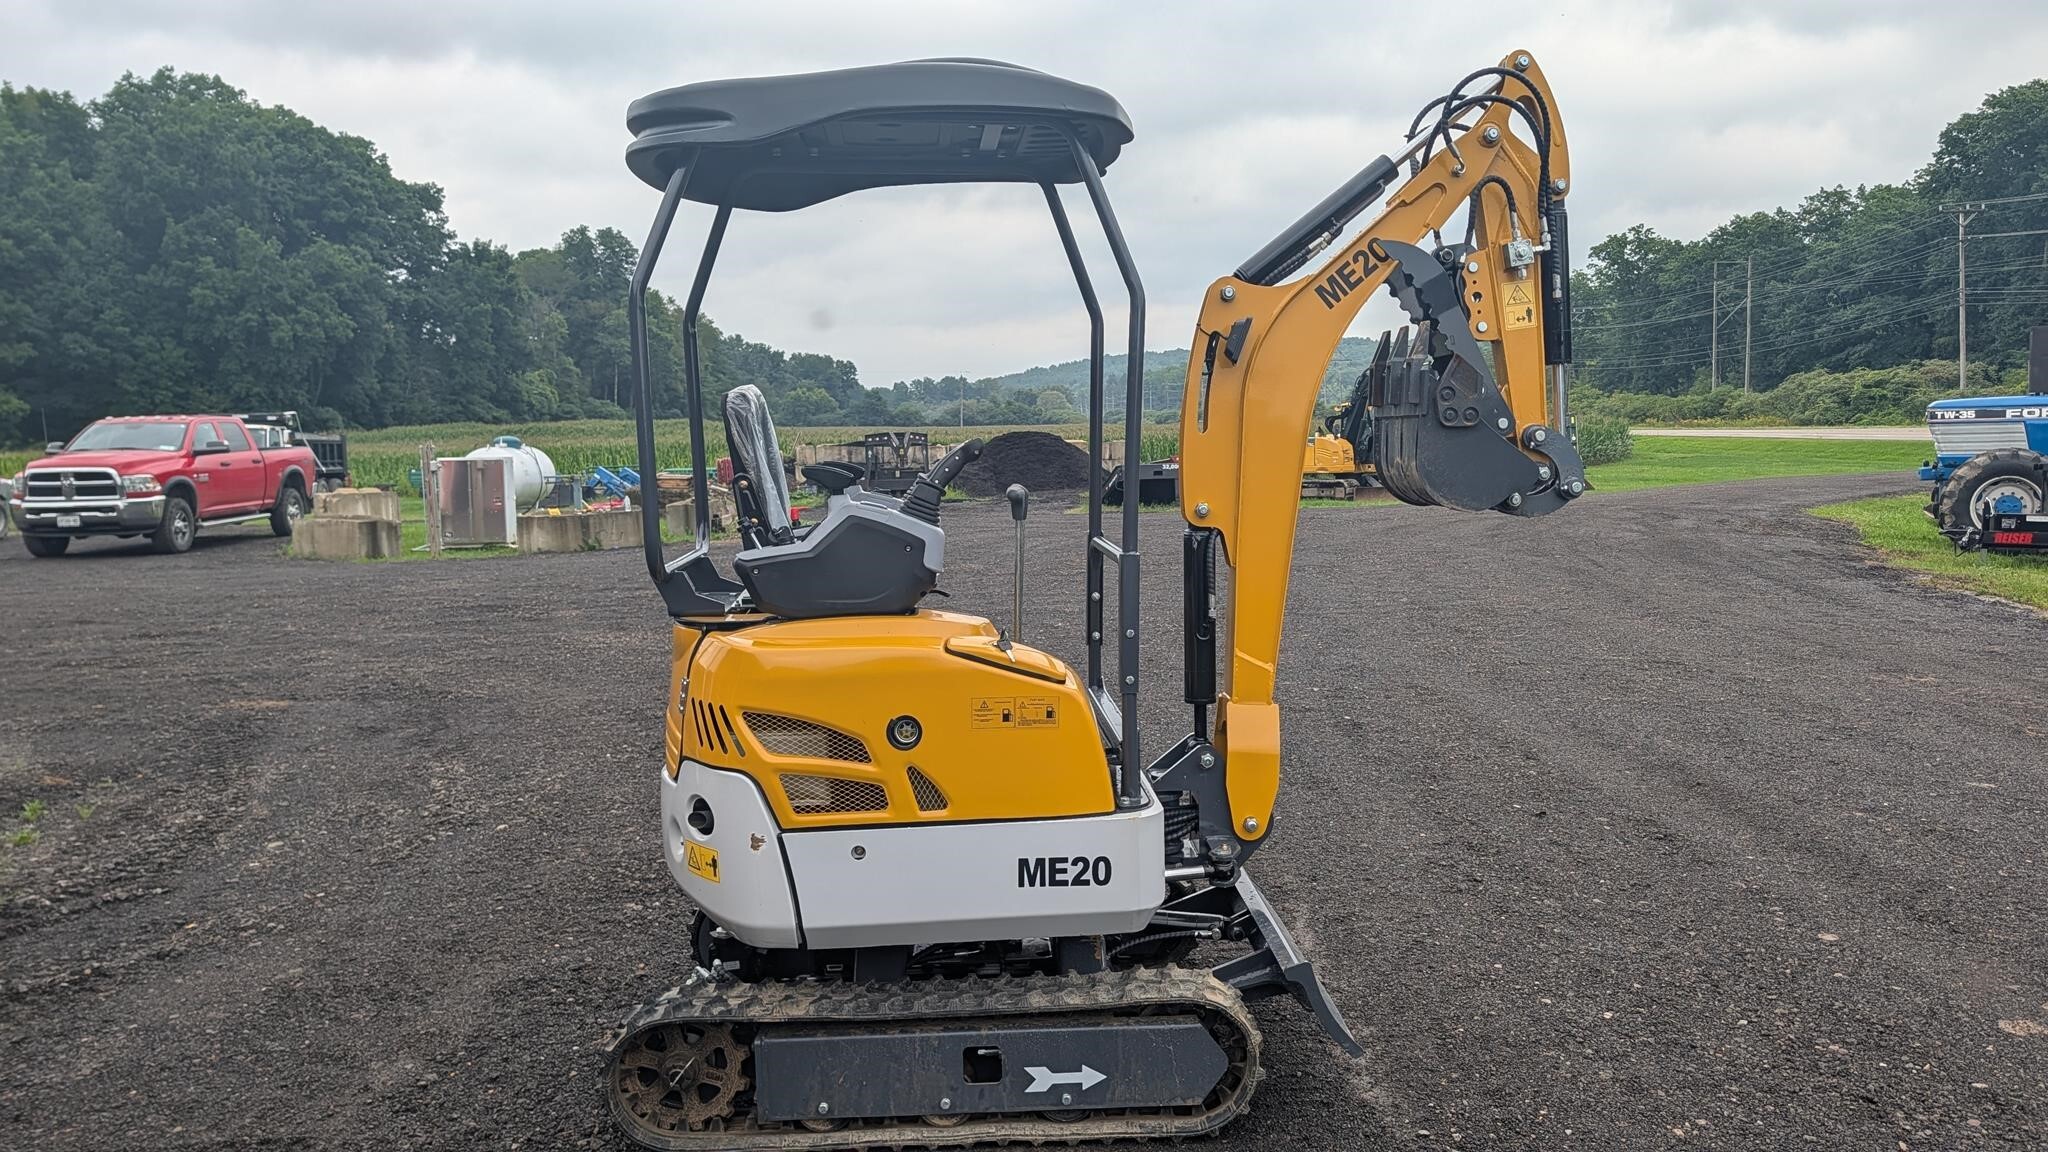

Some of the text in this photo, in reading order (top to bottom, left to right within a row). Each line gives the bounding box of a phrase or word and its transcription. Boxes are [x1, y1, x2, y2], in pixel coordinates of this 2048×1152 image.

[1314, 237, 1390, 310] ME20
[1935, 410, 1976, 419] TW-35
[1994, 532, 2033, 544] REISER
[1018, 856, 1112, 887] ME20
